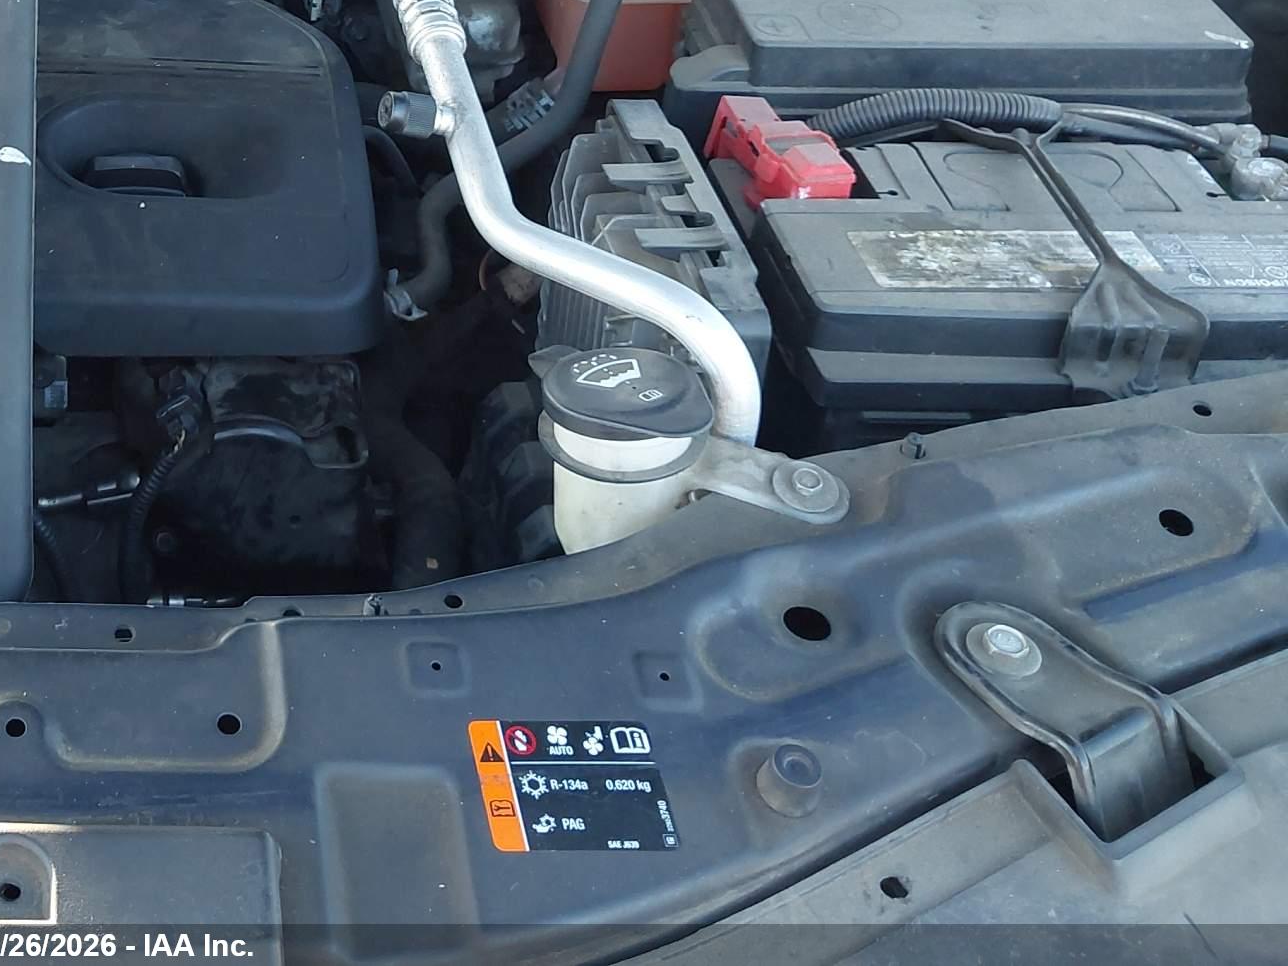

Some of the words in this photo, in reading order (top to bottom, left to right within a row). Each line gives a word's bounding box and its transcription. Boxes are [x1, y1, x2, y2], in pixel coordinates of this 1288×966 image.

[549, 746, 574, 755] AUTO
[550, 779, 589, 790] R-134a
[605, 780, 635, 791] 0.620
[636, 780, 652, 793] kg
[562, 818, 585, 830] PAG
